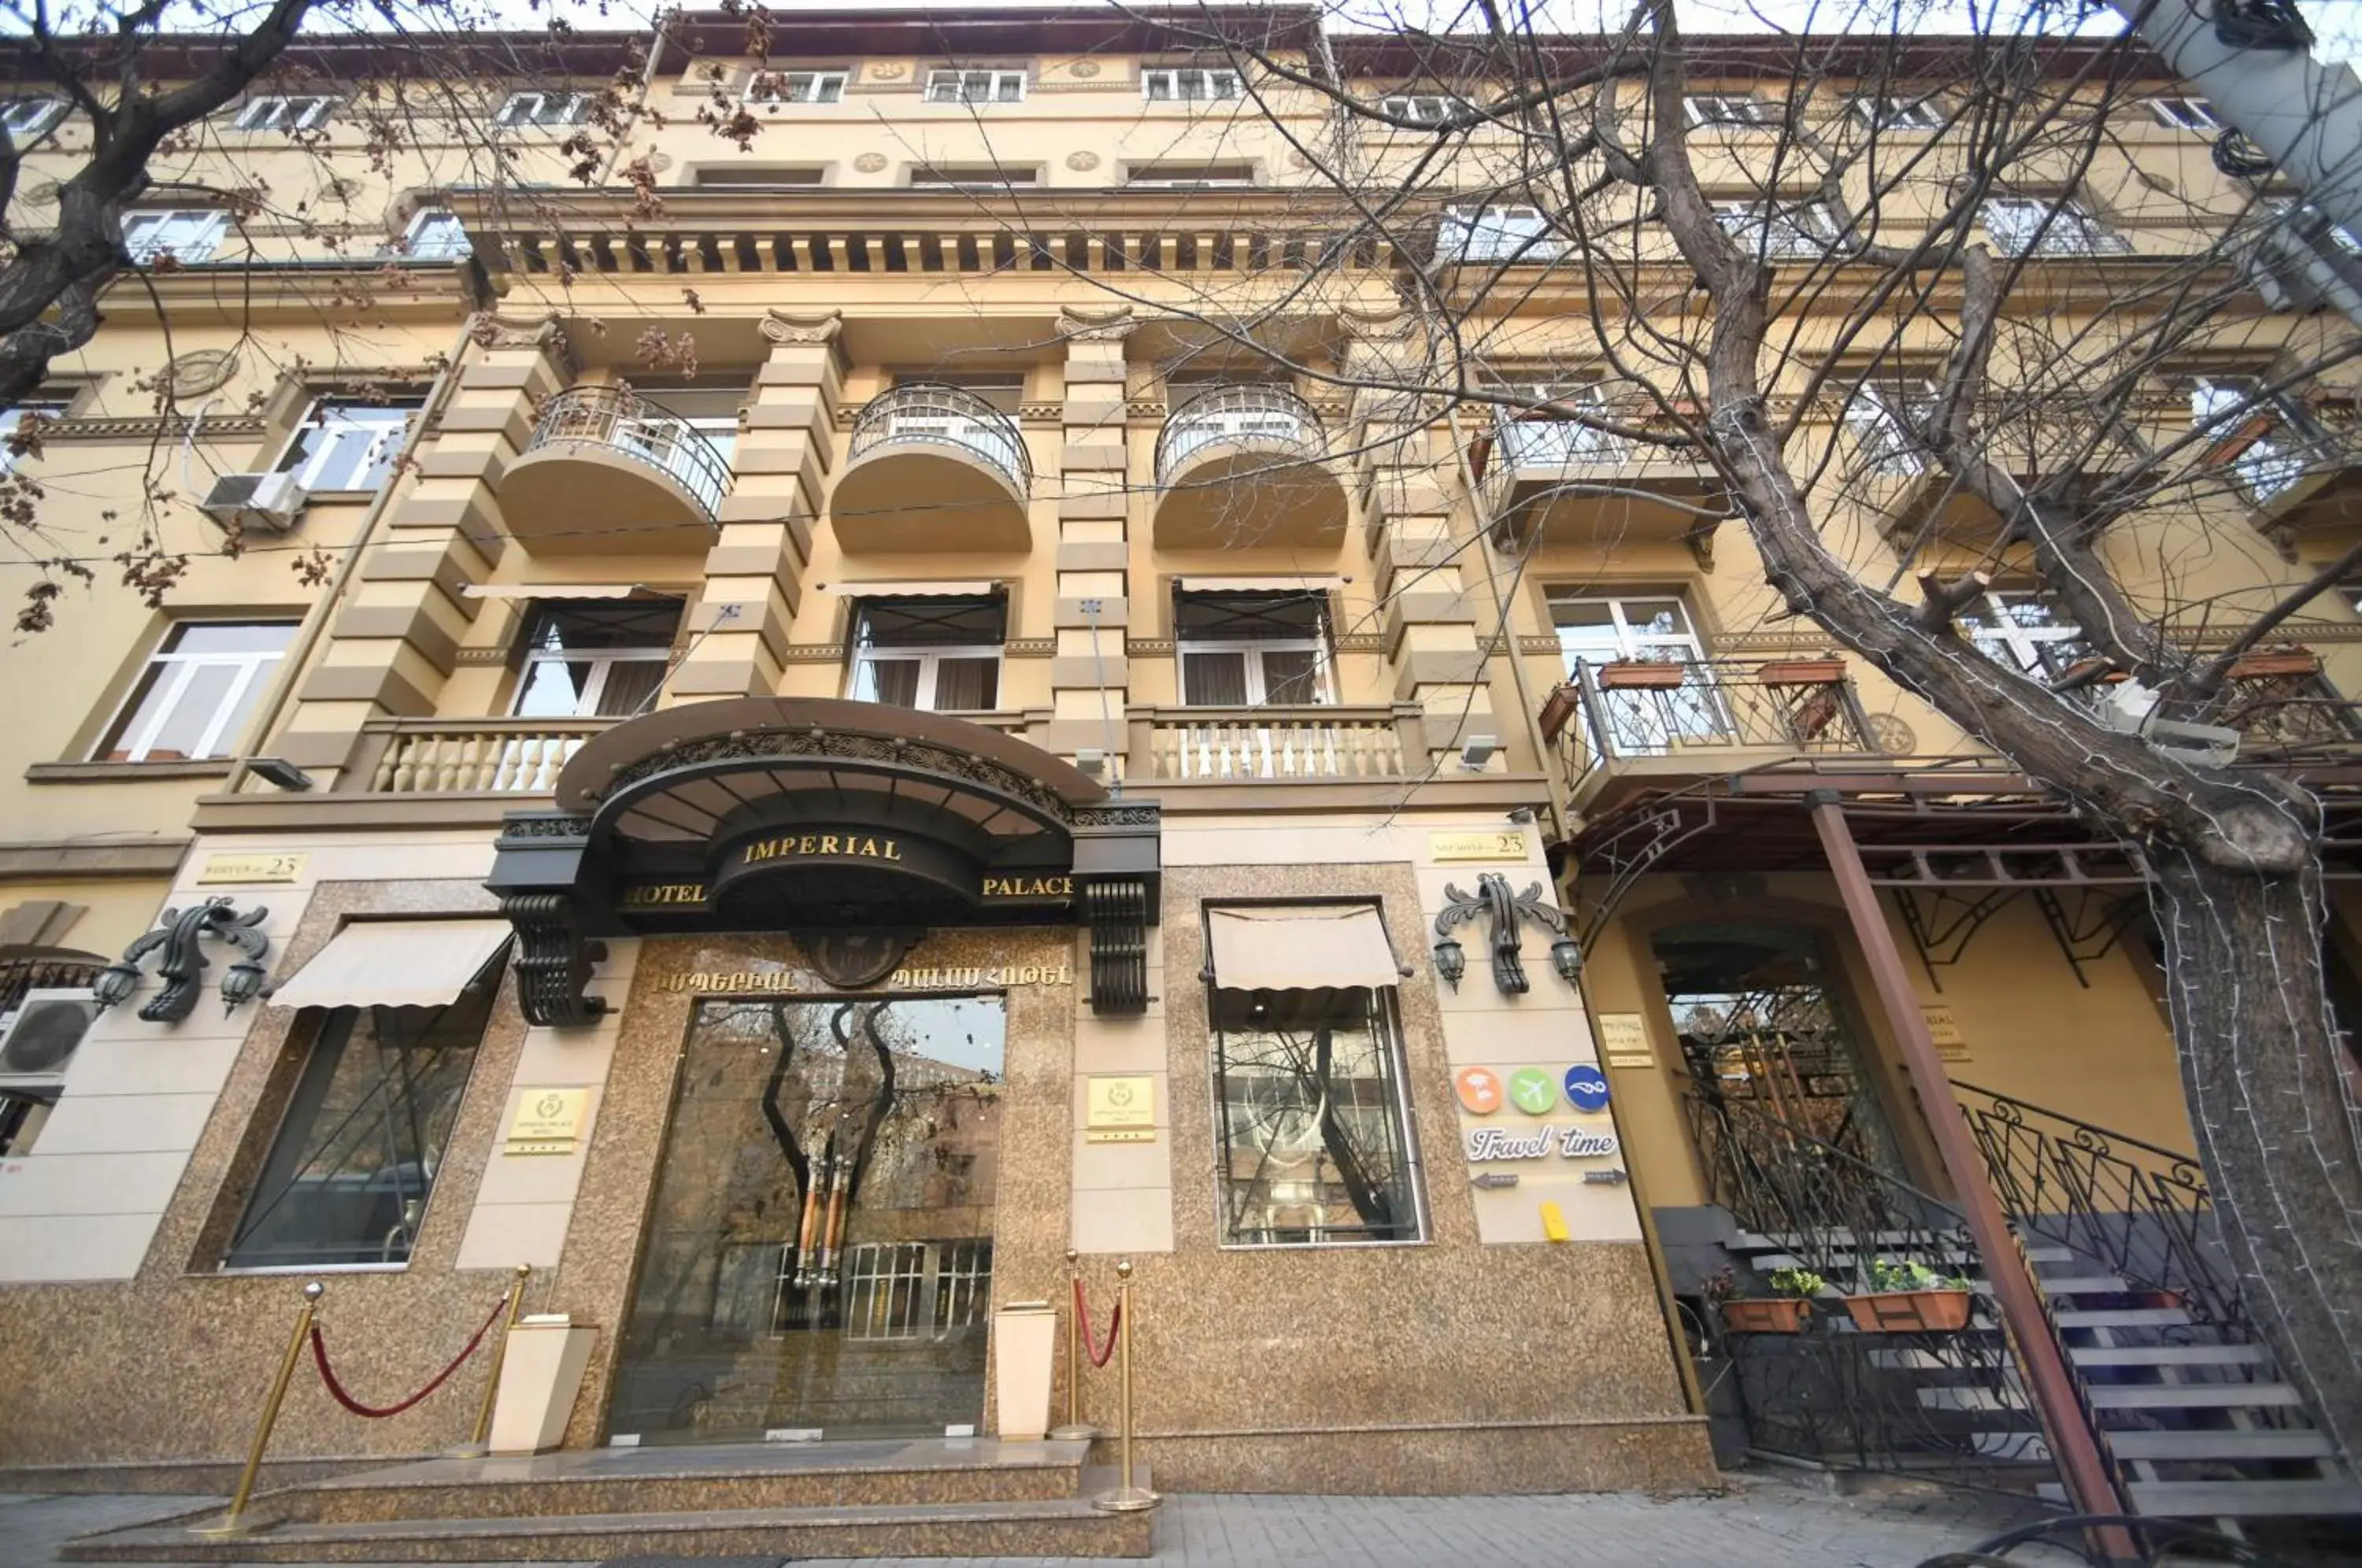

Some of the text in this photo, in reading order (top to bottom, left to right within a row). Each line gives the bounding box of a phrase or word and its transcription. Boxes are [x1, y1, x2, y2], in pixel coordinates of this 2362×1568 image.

[1498, 835, 1523, 852] 23
[623, 884, 708, 904] HOTEL
[743, 835, 901, 864] IMPERIAL
[890, 967, 981, 989] ՊԱԼԱՍ
[986, 965, 1073, 986] ՀՈԹԵԼ
[1470, 1125, 1615, 1160] Travel time
